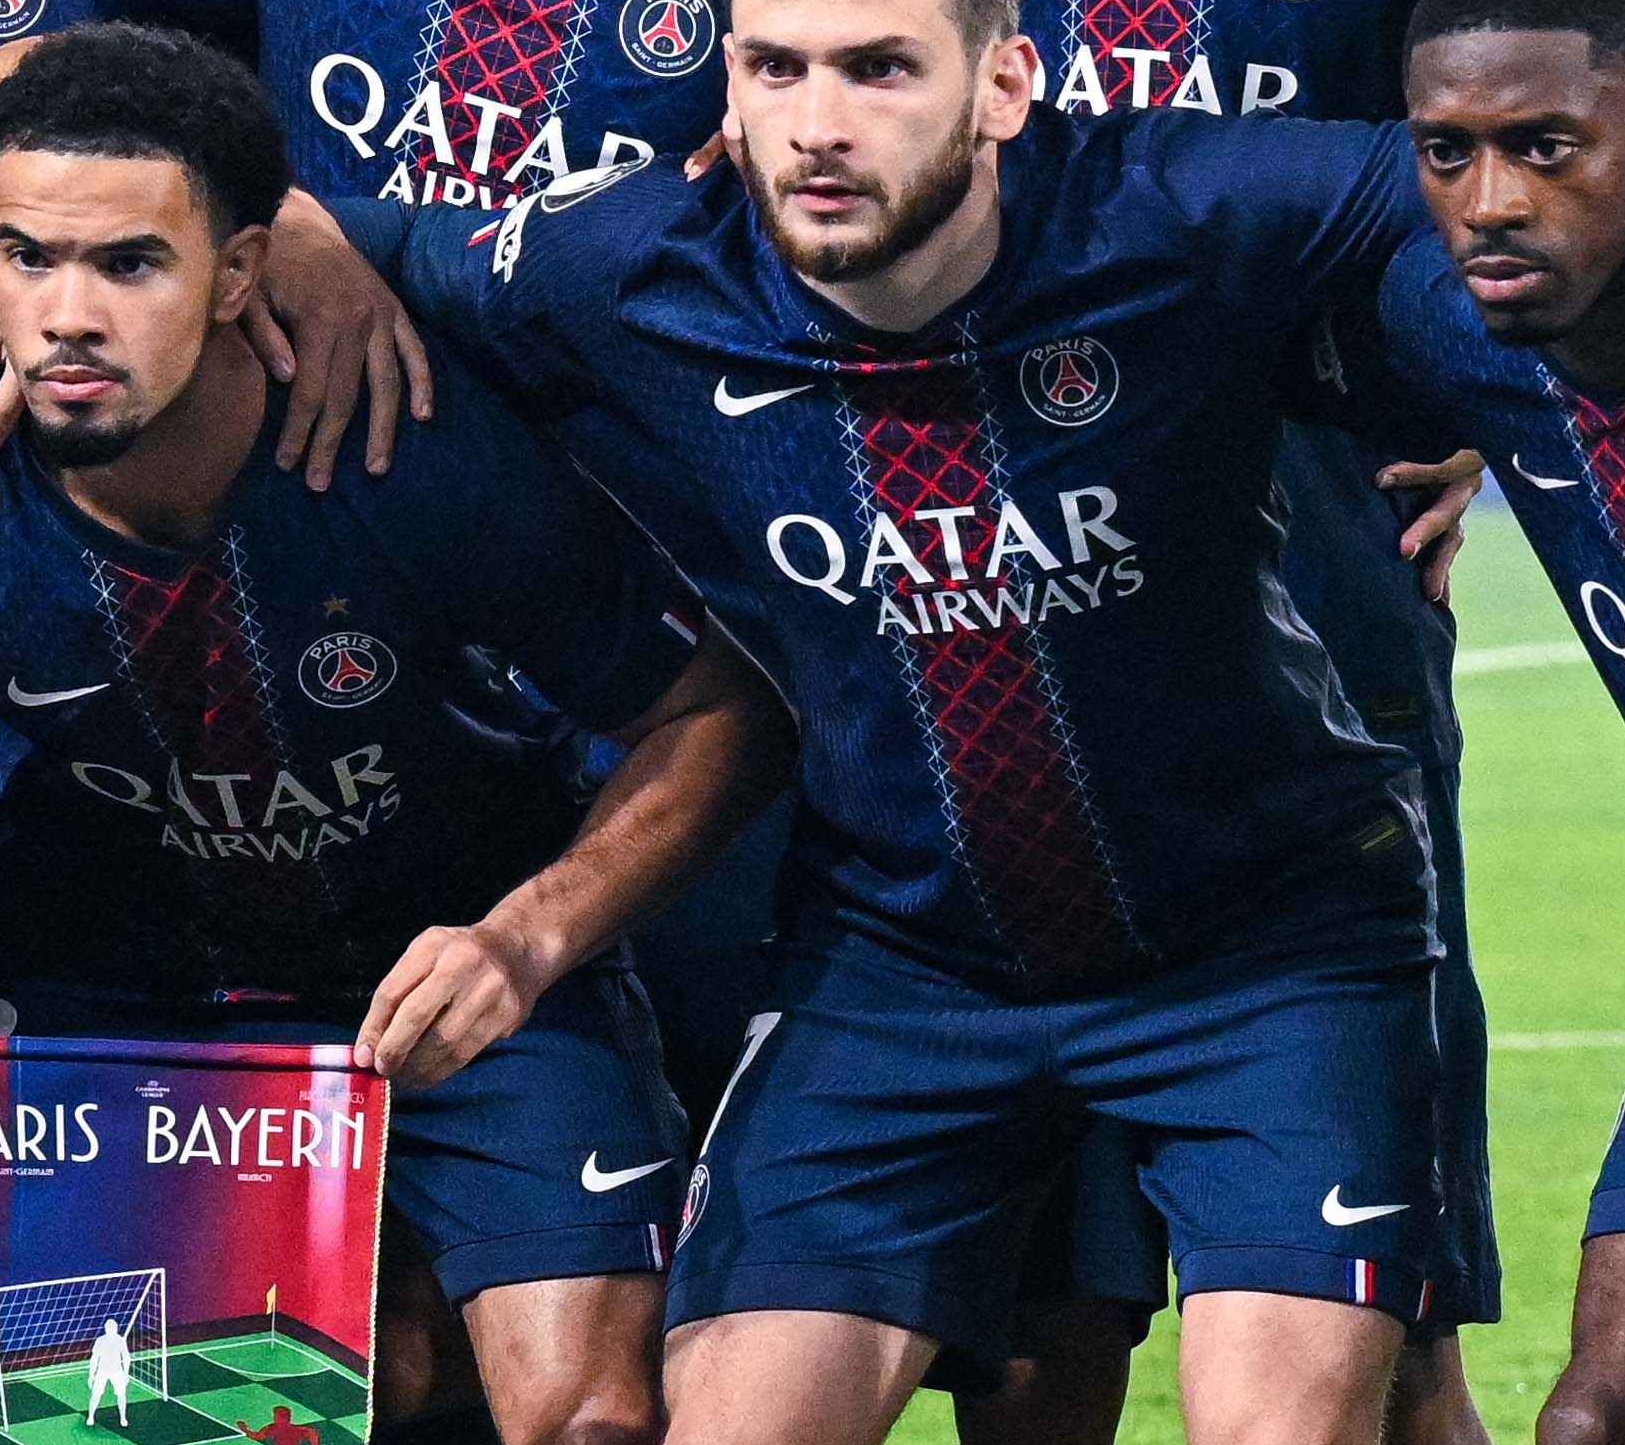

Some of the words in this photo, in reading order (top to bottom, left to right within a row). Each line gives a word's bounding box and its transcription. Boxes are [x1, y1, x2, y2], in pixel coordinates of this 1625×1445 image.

[1030, 44, 1299, 117] ATAR
[1030, 339, 1095, 362] PARIS
[765, 484, 1138, 606] QATAR
[875, 554, 1145, 636] AIRWAYS
[309, 635, 373, 660] PARIS
[70, 743, 397, 829] QATAR
[160, 783, 401, 863] AIRWAYS
[146, 1104, 365, 1170] BAYERN
